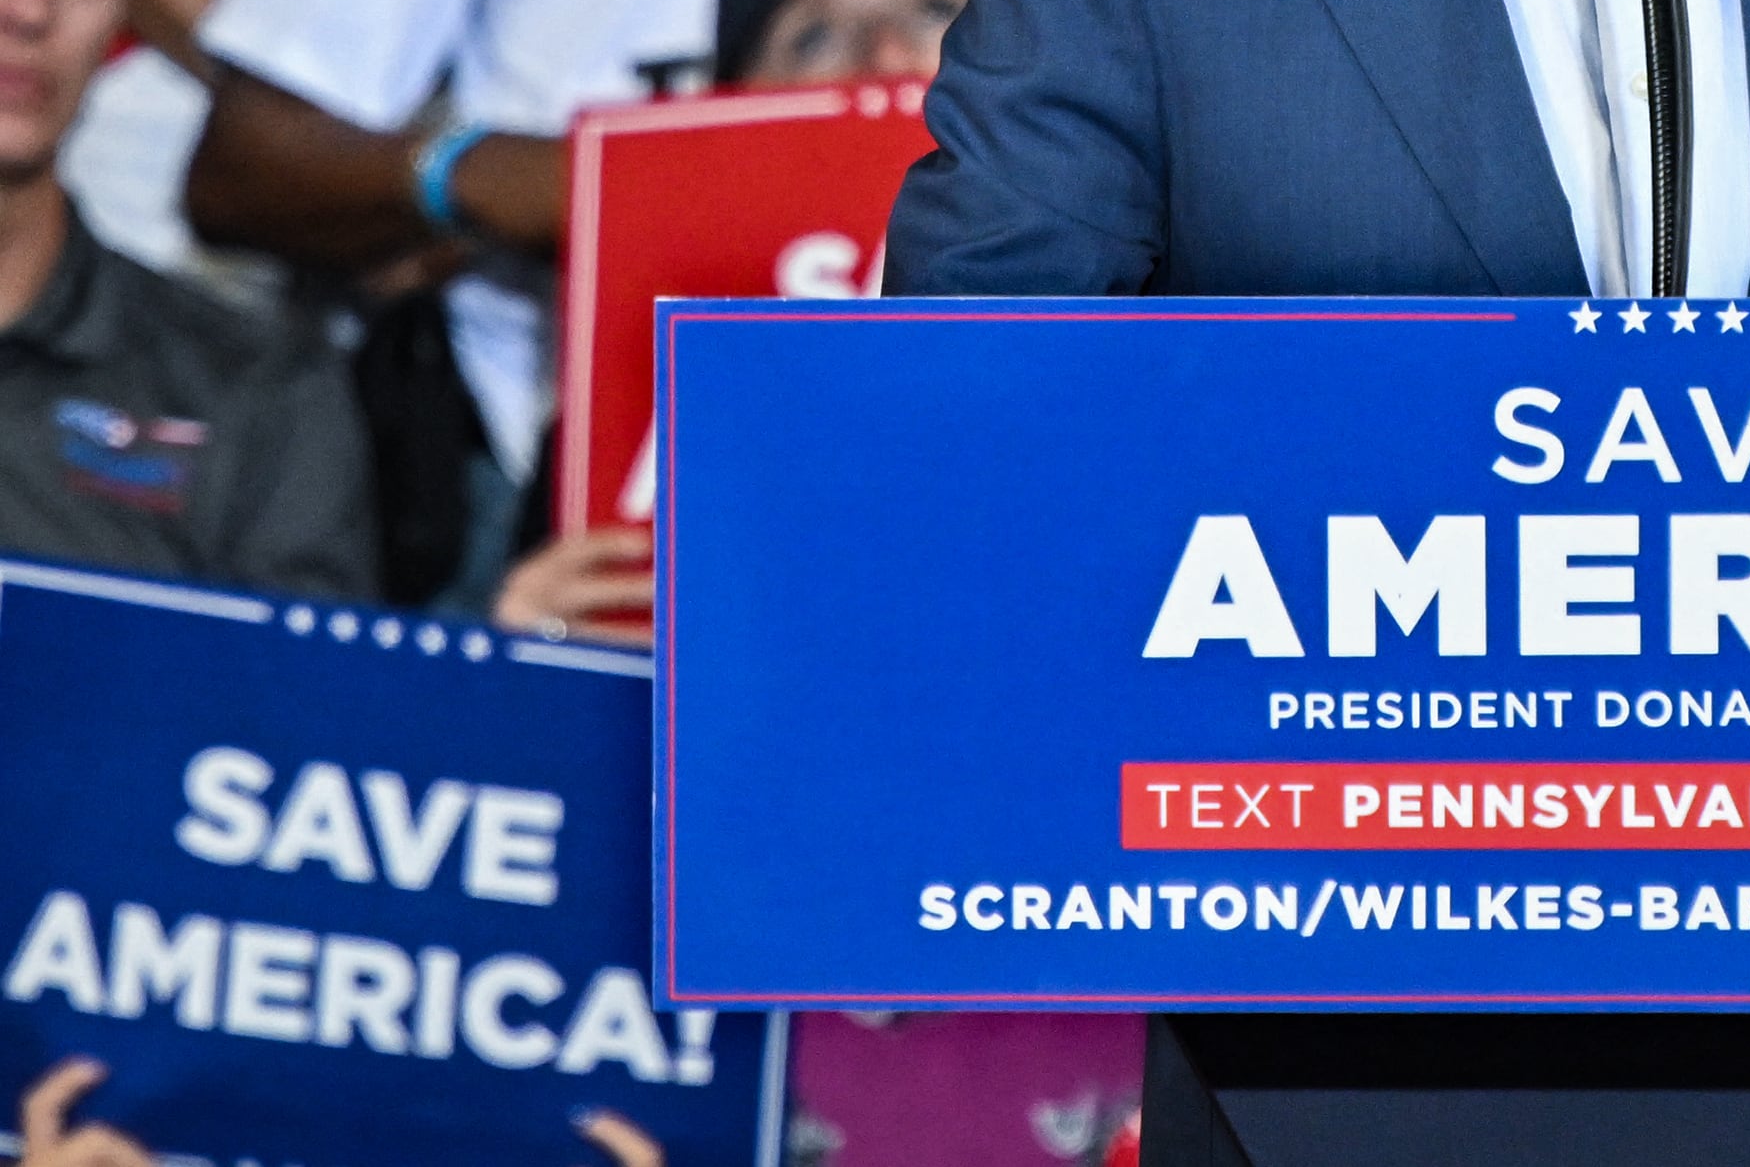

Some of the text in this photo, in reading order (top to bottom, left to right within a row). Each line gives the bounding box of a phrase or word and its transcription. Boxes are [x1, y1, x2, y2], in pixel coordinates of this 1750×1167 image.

[1268, 691, 1574, 730] PRESIDENT
[178, 747, 564, 906] SAVE
[1145, 783, 1316, 829] TEXT
[6, 889, 718, 1087] AMERICA!
